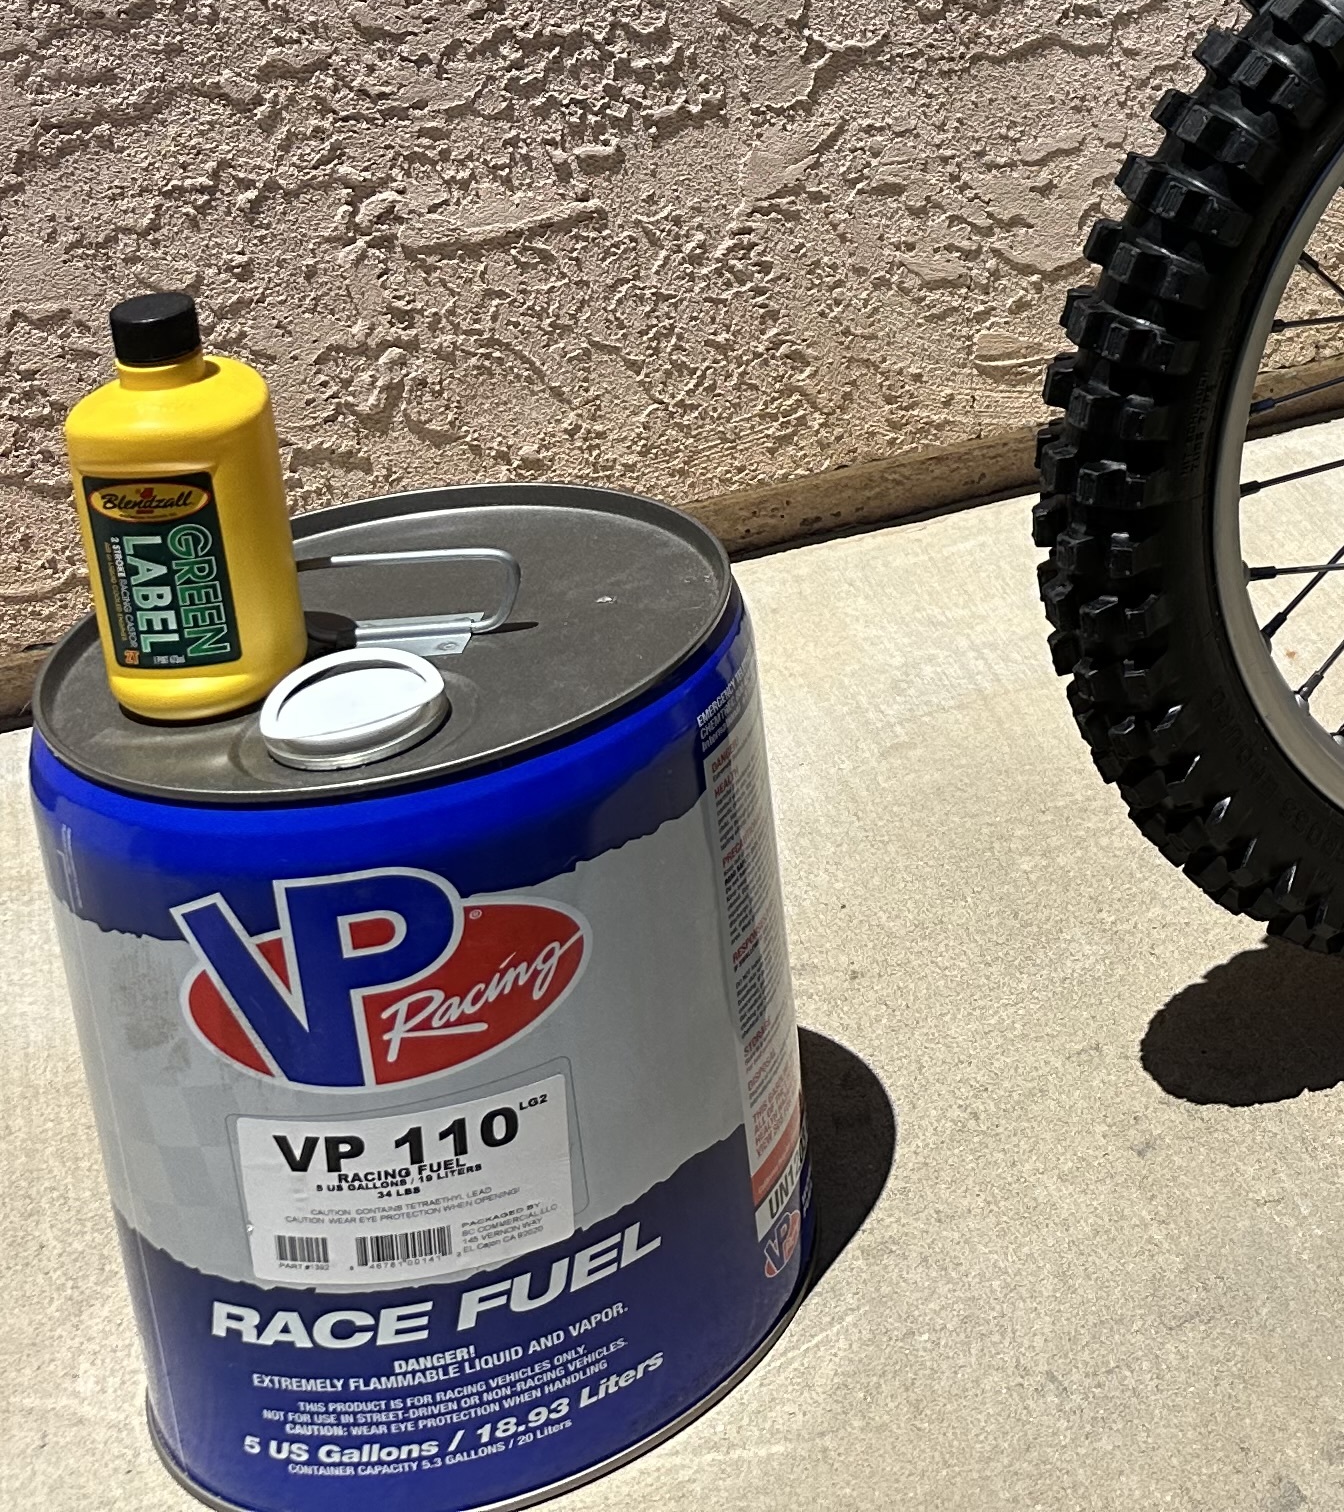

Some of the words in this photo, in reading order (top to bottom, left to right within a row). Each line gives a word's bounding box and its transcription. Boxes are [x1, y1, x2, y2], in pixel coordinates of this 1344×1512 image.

[100, 490, 195, 510] Blendzall
[112, 544, 127, 578] STROKE
[121, 578, 133, 616] RACING
[123, 535, 181, 654] LABEL
[167, 523, 231, 658] GREEN
[125, 613, 139, 649] CASTOR
[169, 866, 466, 1088] VP
[379, 930, 586, 1063] Racing
[272, 1134, 365, 1173] VP
[394, 1106, 520, 1166] 110
[518, 1092, 549, 1111] LG2
[326, 1184, 344, 1192] US
[347, 1178, 408, 1192] GALLONS
[436, 1163, 483, 1180] LITERS
[338, 1167, 412, 1184] RACING
[417, 1157, 467, 1176] FUEL
[355, 1204, 404, 1216] CONTAINS
[405, 1193, 464, 1209] TETRAETHYL
[466, 1186, 493, 1199] LEAD
[377, 1190, 393, 1199] 34
[396, 1186, 422, 1197] LBS
[284, 1215, 325, 1224] CAUTION
[359, 1216, 378, 1224] EYE
[380, 1206, 442, 1223] PROTECTION
[443, 1201, 473, 1212] WHEN
[461, 1207, 525, 1228] PACKAGED
[526, 1201, 542, 1211] BY
[477, 1210, 539, 1234] COMMERCIAL
[540, 1203, 559, 1215] LLC
[481, 1224, 521, 1241] VERNON
[522, 1217, 543, 1229] WAY
[463, 1245, 474, 1253] EL
[476, 1239, 502, 1251] Cajon
[502, 1233, 517, 1243] CA
[763, 1211, 791, 1275] VP
[211, 1300, 433, 1348] RACE
[456, 1221, 662, 1331] FUEL
[252, 1373, 345, 1392] EXTREMELY
[349, 1363, 460, 1391] FLAMMABLE
[464, 1345, 524, 1375] LIQUID
[528, 1329, 565, 1355] AND
[569, 1302, 629, 1337] VAPOR.
[394, 1345, 476, 1374] DANGER!
[262, 1409, 285, 1422] NOT
[288, 1412, 312, 1423] FOR
[314, 1413, 338, 1424] USE
[340, 1414, 354, 1424] IN
[355, 1399, 459, 1425] STREET-DRIVEN
[461, 1392, 480, 1409] OR
[482, 1366, 566, 1402] NON-RACING
[568, 1338, 629, 1372] VEHICLES.
[297, 1401, 326, 1412] THIS
[328, 1400, 387, 1412] PRODUCT
[390, 1399, 404, 1410] IS
[407, 1395, 433, 1408] FOR
[436, 1381, 487, 1403] RACING
[489, 1360, 552, 1389] VEHICLES
[554, 1344, 588, 1365] ONLY.
[243, 1435, 261, 1454] 5
[268, 1440, 310, 1462] US
[317, 1440, 440, 1464] Gallons
[446, 1429, 466, 1452] /
[476, 1397, 571, 1444] 18.93
[578, 1351, 665, 1408] Liters
[285, 1423, 348, 1436] CAUTION:
[351, 1424, 388, 1436] WEAR
[390, 1421, 416, 1433] EYE
[418, 1402, 501, 1430] PROTECTION
[502, 1390, 542, 1409] WHEN
[544, 1360, 608, 1395] HANDLING
[287, 1463, 355, 1476] CONTAINER
[357, 1461, 419, 1476] CAPACITY
[421, 1457, 443, 1469] 5.3
[444, 1442, 506, 1466] GALLONS
[508, 1439, 514, 1449] /
[517, 1433, 534, 1445] 20
[536, 1419, 573, 1439] Liters
